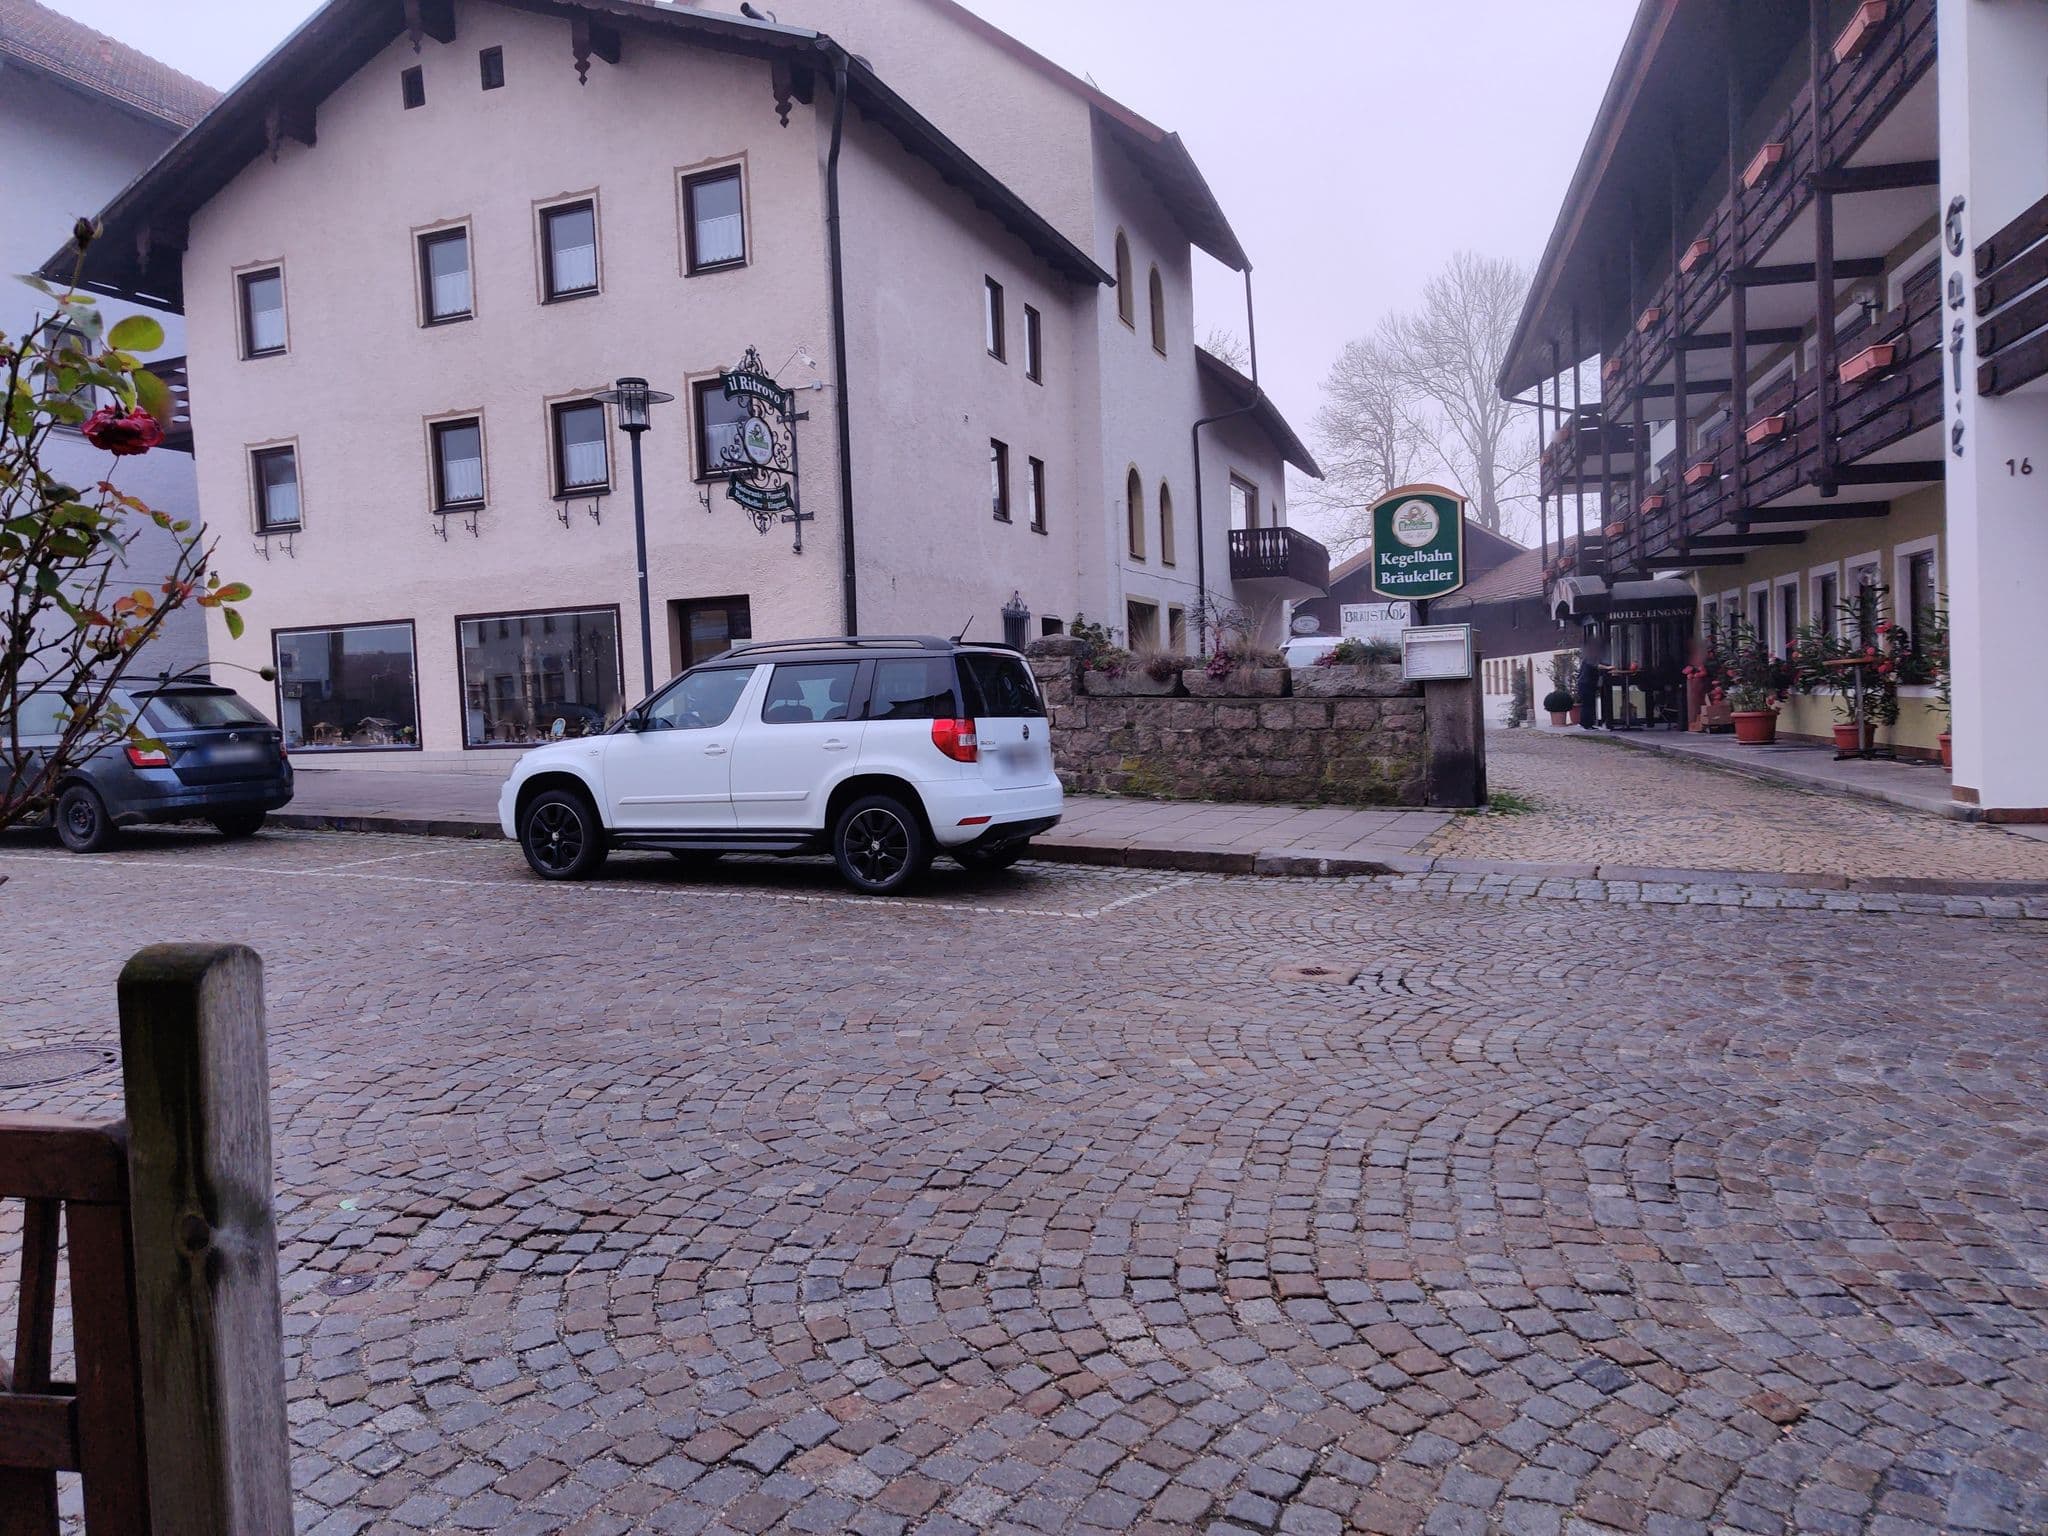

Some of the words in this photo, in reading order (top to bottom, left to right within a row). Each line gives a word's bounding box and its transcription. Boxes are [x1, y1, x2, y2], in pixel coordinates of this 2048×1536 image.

[728, 375, 738, 391] il
[739, 375, 781, 404] Ritrovo
[2005, 457, 2034, 477] 16
[1380, 550, 1453, 568] Kegelbahn
[1380, 569, 1454, 585] Bräukeller
